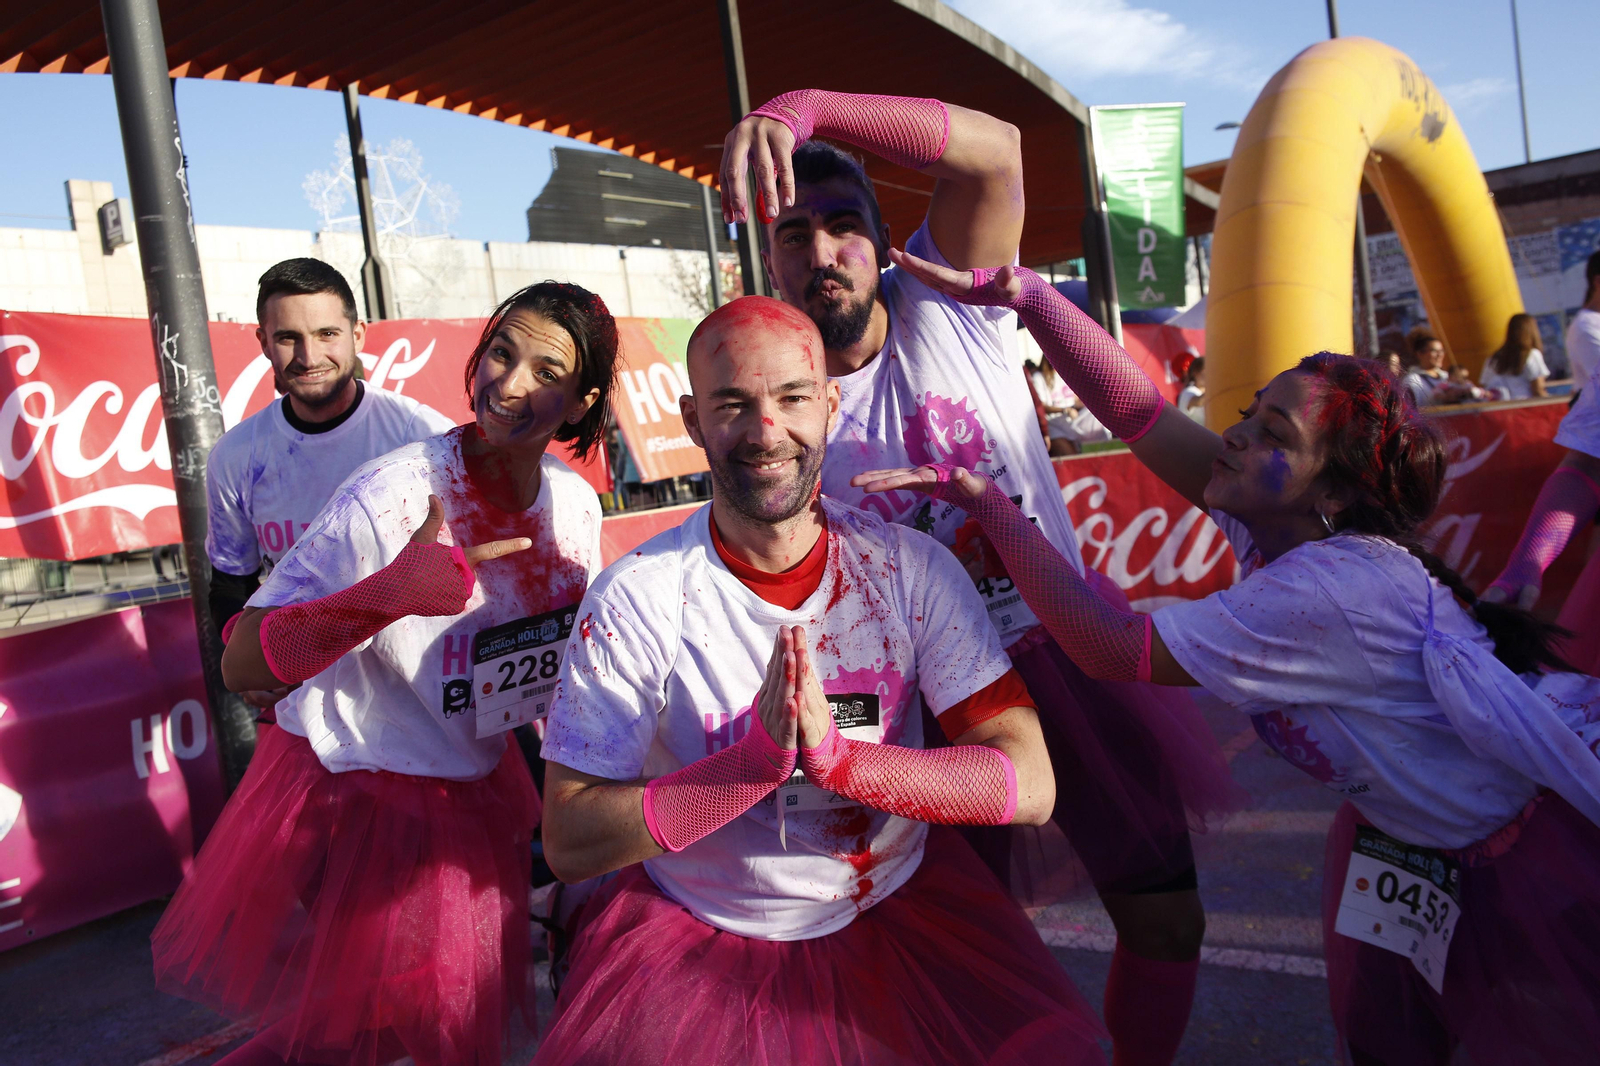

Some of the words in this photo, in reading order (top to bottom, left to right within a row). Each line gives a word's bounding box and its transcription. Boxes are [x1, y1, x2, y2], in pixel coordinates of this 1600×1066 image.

[106, 205, 119, 231] P
[976, 577, 1016, 598] 45
[479, 637, 516, 657] GRANADA
[517, 629, 540, 644] HOLI
[498, 649, 563, 693] 228
[131, 699, 208, 779] HO
[1359, 837, 1406, 861] GRANADA
[1407, 852, 1430, 871] HOLI
[1376, 870, 1450, 934] 0453
